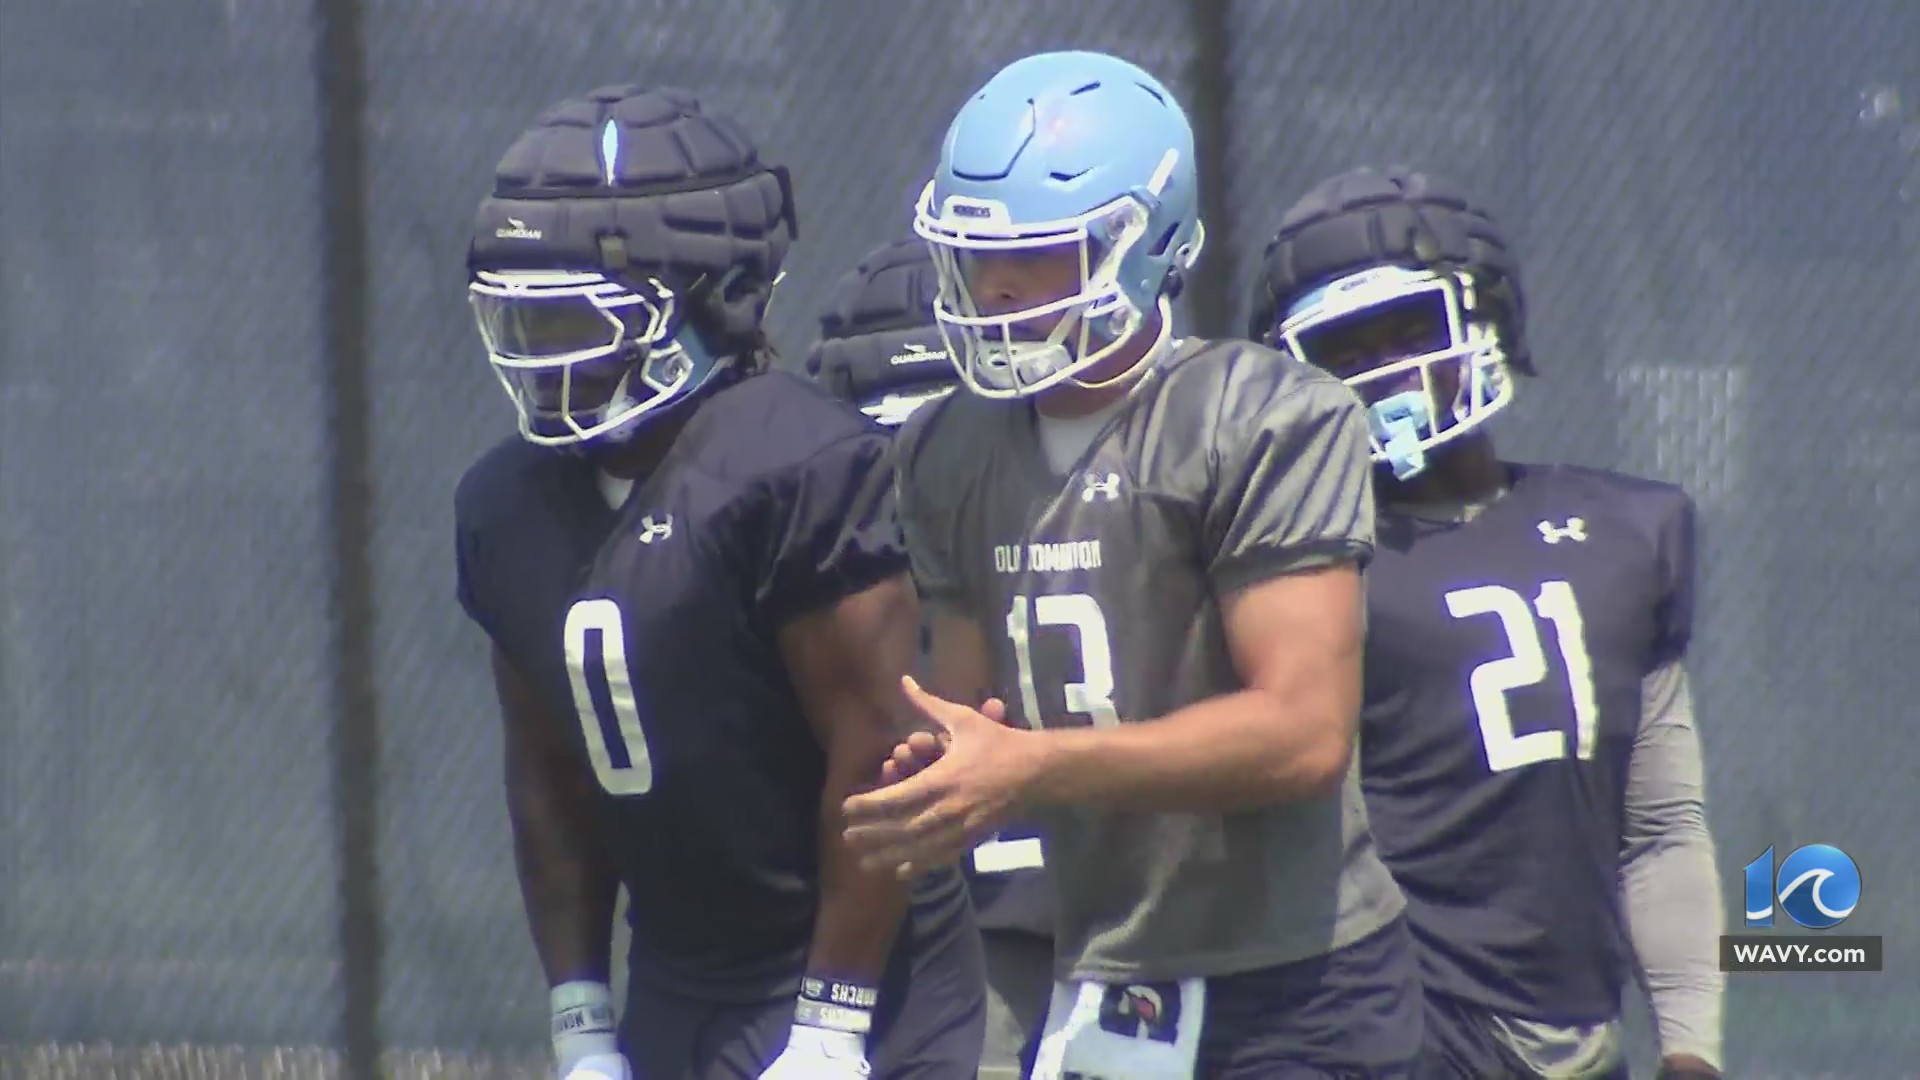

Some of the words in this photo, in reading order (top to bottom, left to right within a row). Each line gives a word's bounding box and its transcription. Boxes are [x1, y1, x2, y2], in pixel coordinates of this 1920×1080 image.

[563, 599, 652, 795] 0
[1006, 593, 1120, 730] 13
[1444, 580, 1599, 772] 21
